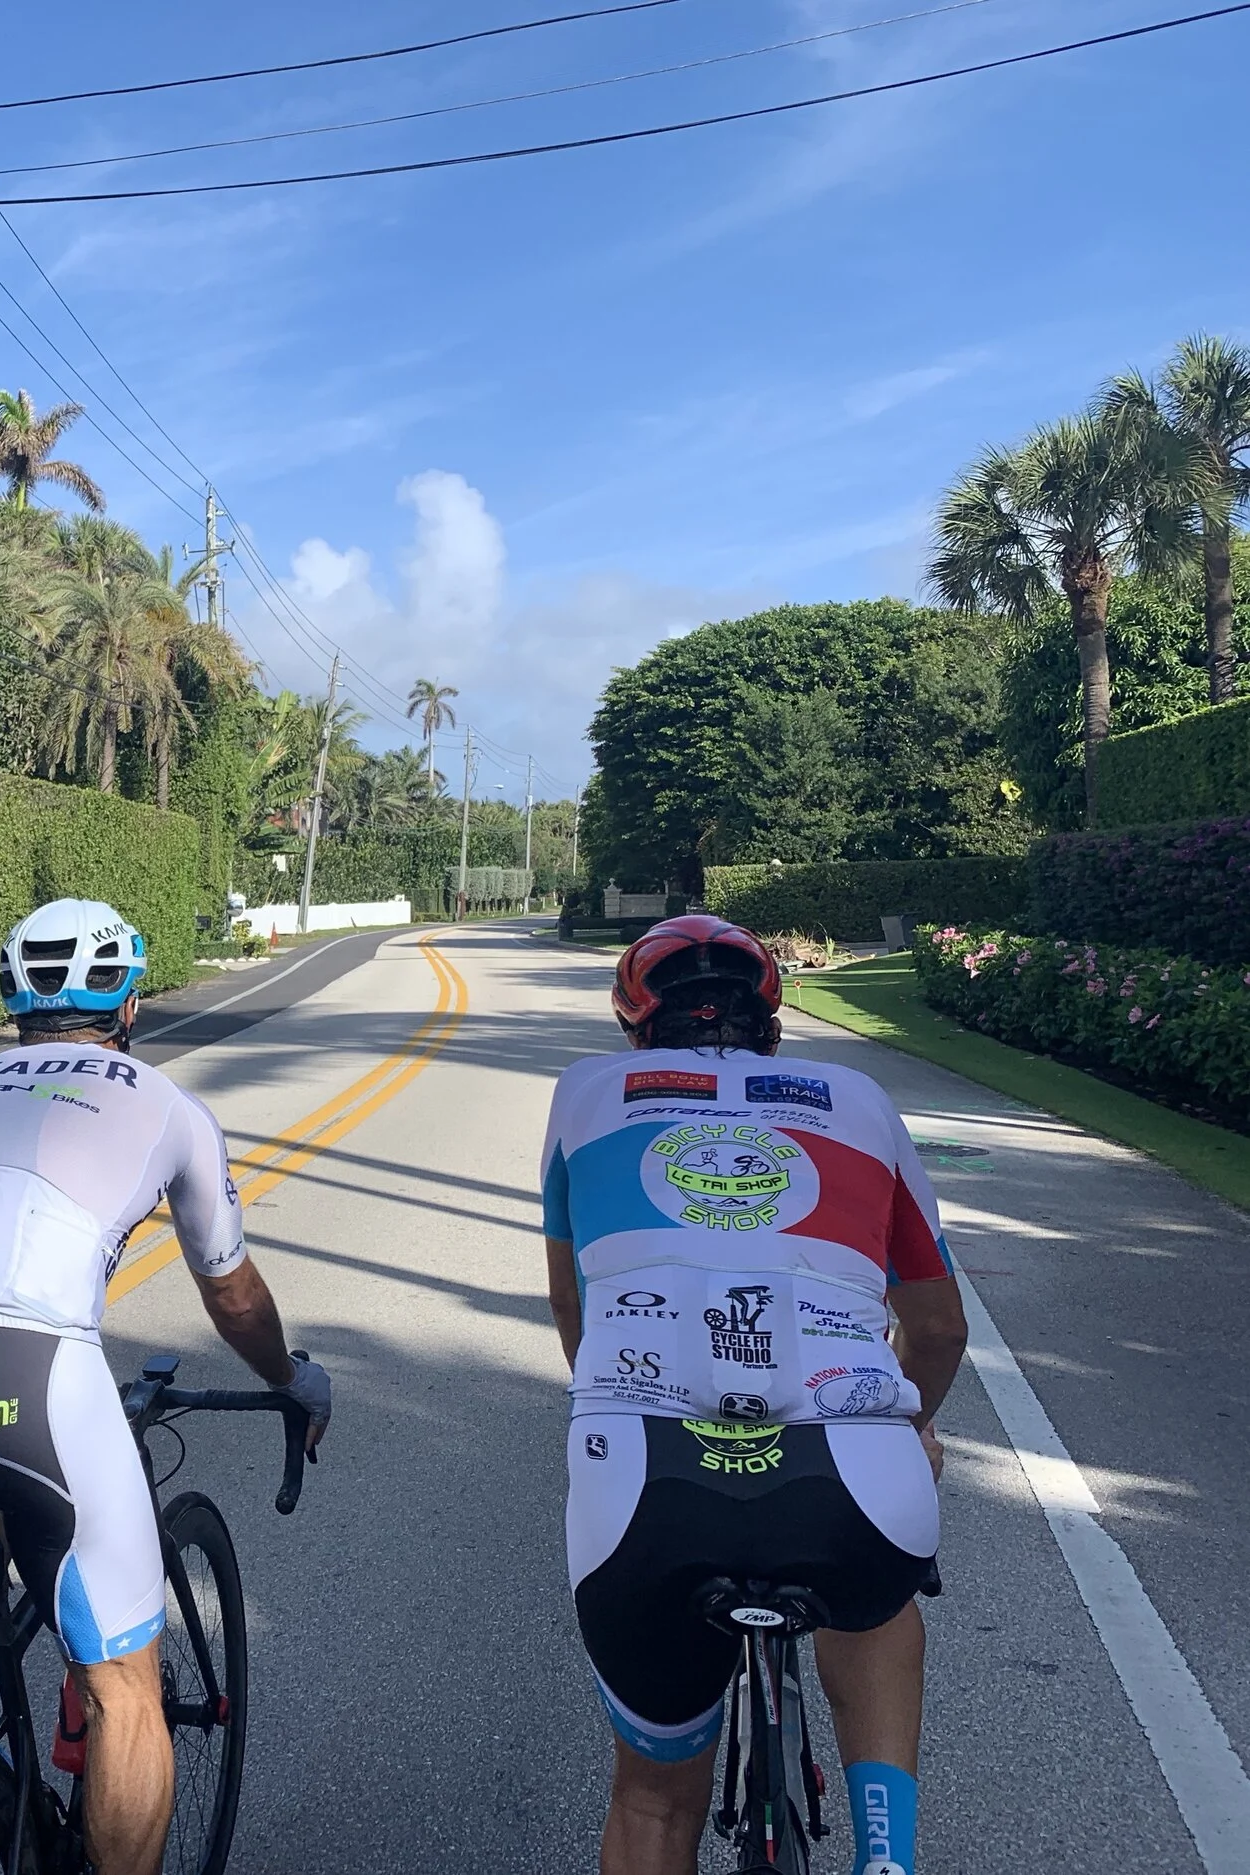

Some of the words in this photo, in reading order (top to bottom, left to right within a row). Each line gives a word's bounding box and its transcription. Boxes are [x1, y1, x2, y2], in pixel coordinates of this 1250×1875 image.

[778, 1075, 825, 1089] DELTA
[52, 1093, 101, 1114] Bikes
[780, 1087, 829, 1104] TRADE
[625, 1107, 753, 1120] corratec
[760, 1109, 821, 1121] PASSION
[778, 1116, 830, 1129] CYCLING
[651, 1124, 802, 1160] BICYCLE
[671, 1169, 694, 1185] LC
[700, 1178, 728, 1191] TRI
[736, 1176, 783, 1191] SHOP
[679, 1204, 779, 1231] SHOP
[605, 1309, 680, 1320] OAKLEY
[797, 1300, 853, 1320] Planet
[711, 1331, 751, 1348] CYCLE
[753, 1335, 772, 1348] FIT
[712, 1343, 771, 1364] STUDIO
[593, 1375, 617, 1384] Simon
[619, 1376, 628, 1384] &
[630, 1377, 667, 1392] Sigalos,
[669, 1384, 690, 1397] LLP
[804, 1366, 851, 1389] NATIONAL
[711, 1422, 737, 1433] TRI
[742, 1423, 776, 1434] SHO
[699, 1448, 784, 1474] SHOP
[864, 1783, 891, 1861] GIRO
